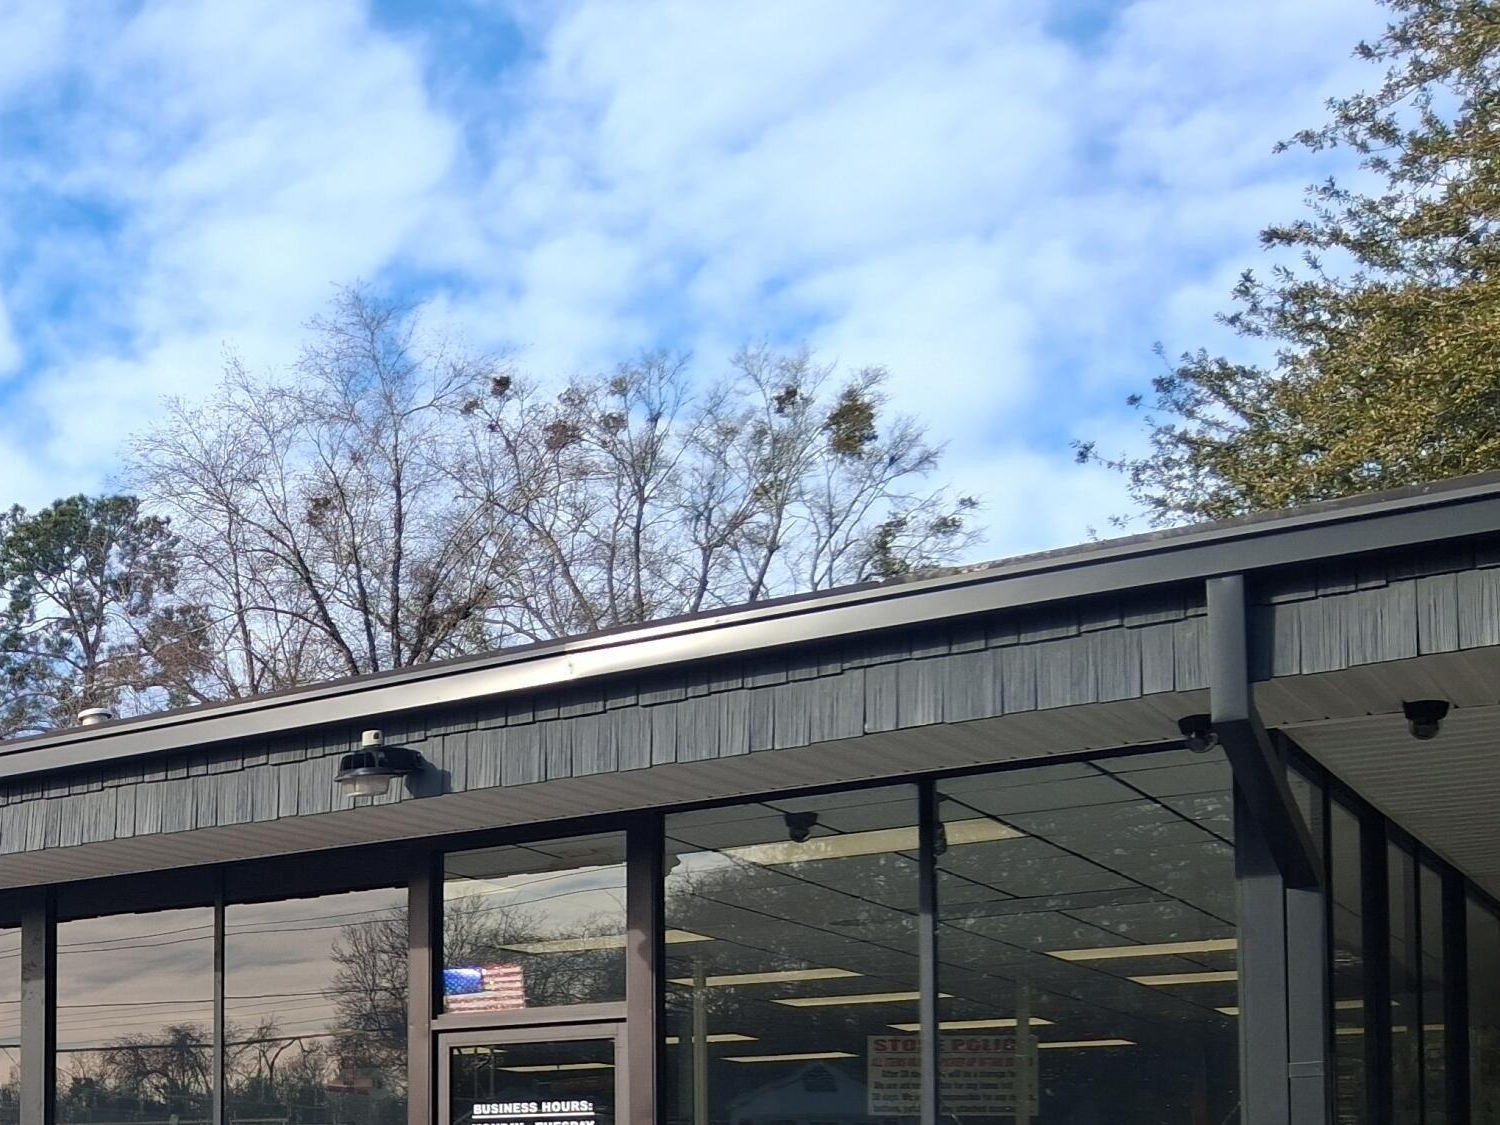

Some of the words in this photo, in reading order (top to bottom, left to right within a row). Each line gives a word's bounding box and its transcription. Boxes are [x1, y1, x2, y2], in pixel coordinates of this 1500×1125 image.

[874, 1039, 944, 1051] STO
[952, 1039, 1017, 1051] POLIC
[473, 1102, 538, 1115] BUSINESS
[541, 1100, 593, 1113] HOURS:
